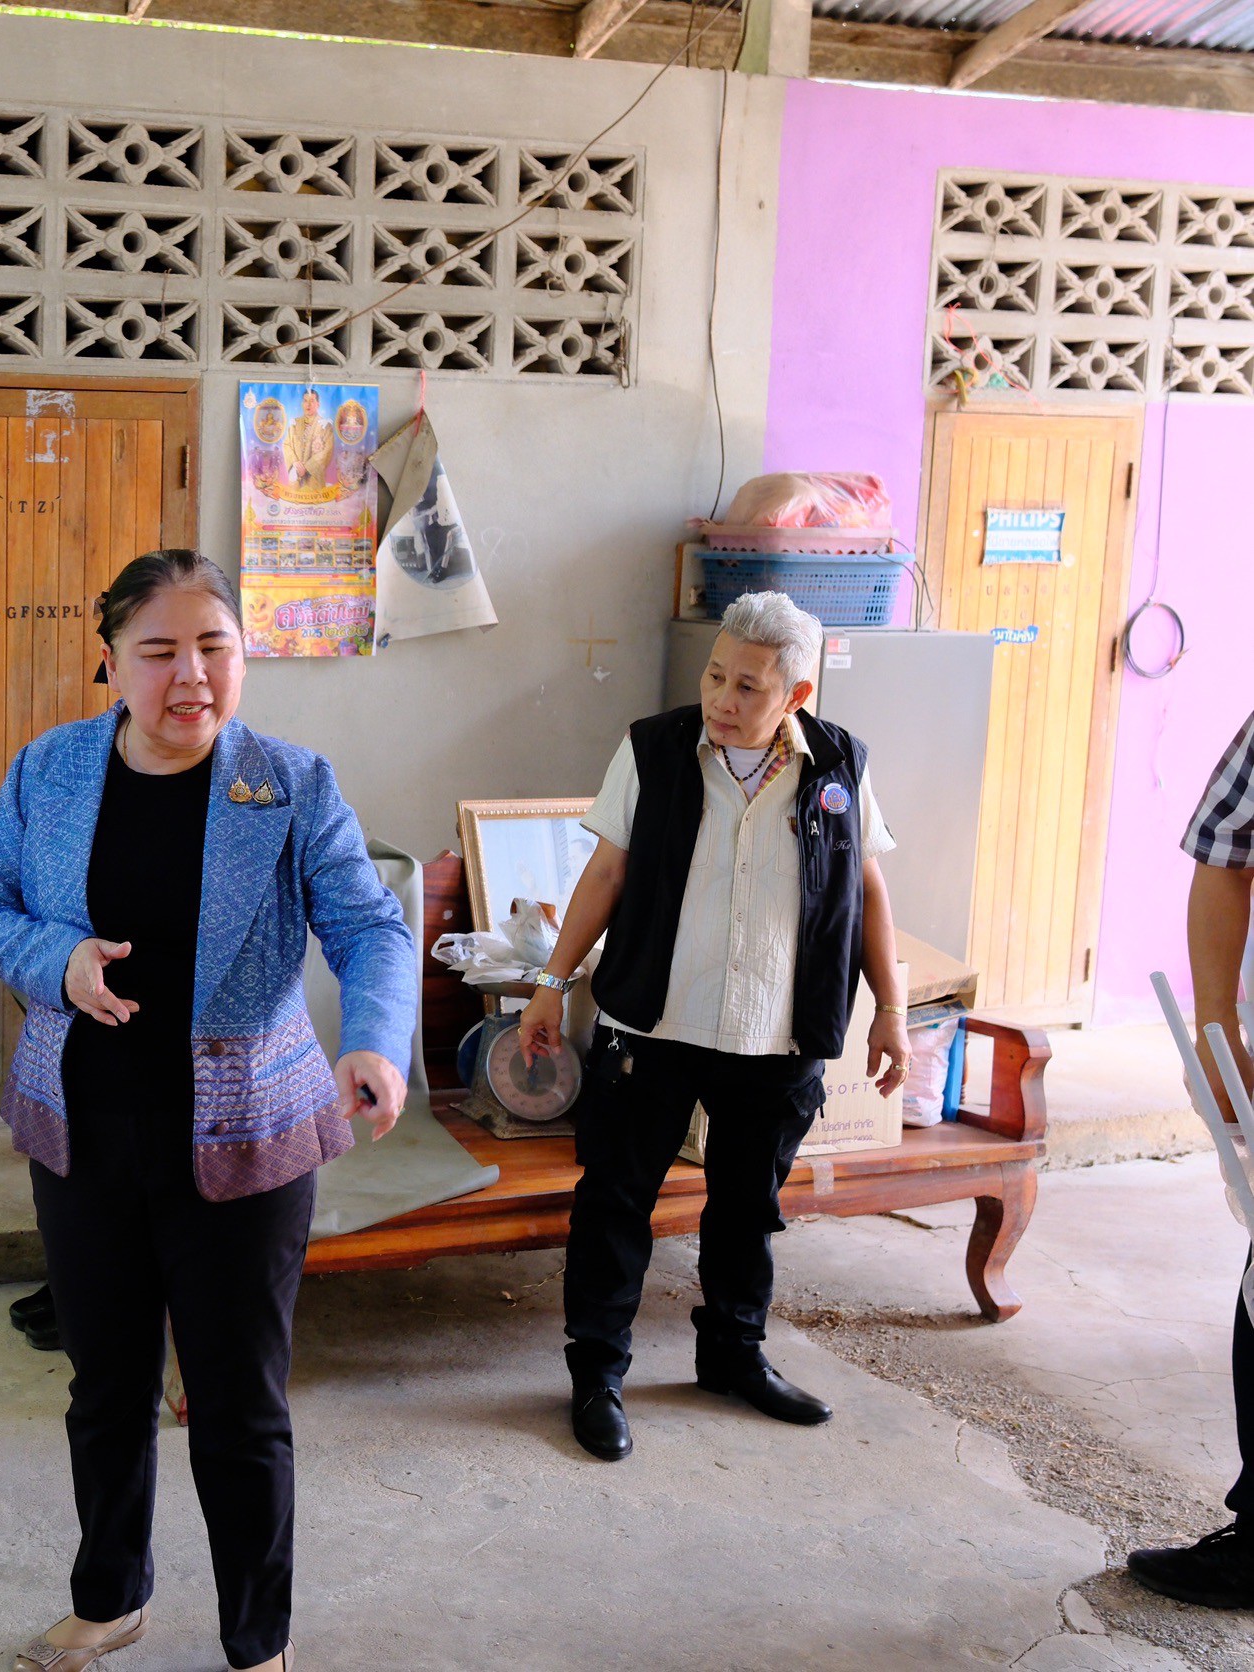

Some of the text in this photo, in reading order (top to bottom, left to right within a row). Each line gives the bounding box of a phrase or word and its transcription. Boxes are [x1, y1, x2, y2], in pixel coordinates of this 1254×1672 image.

[274, 600, 371, 630] สวัสดีปีใหม่
[826, 1081, 870, 1096] SOFT
